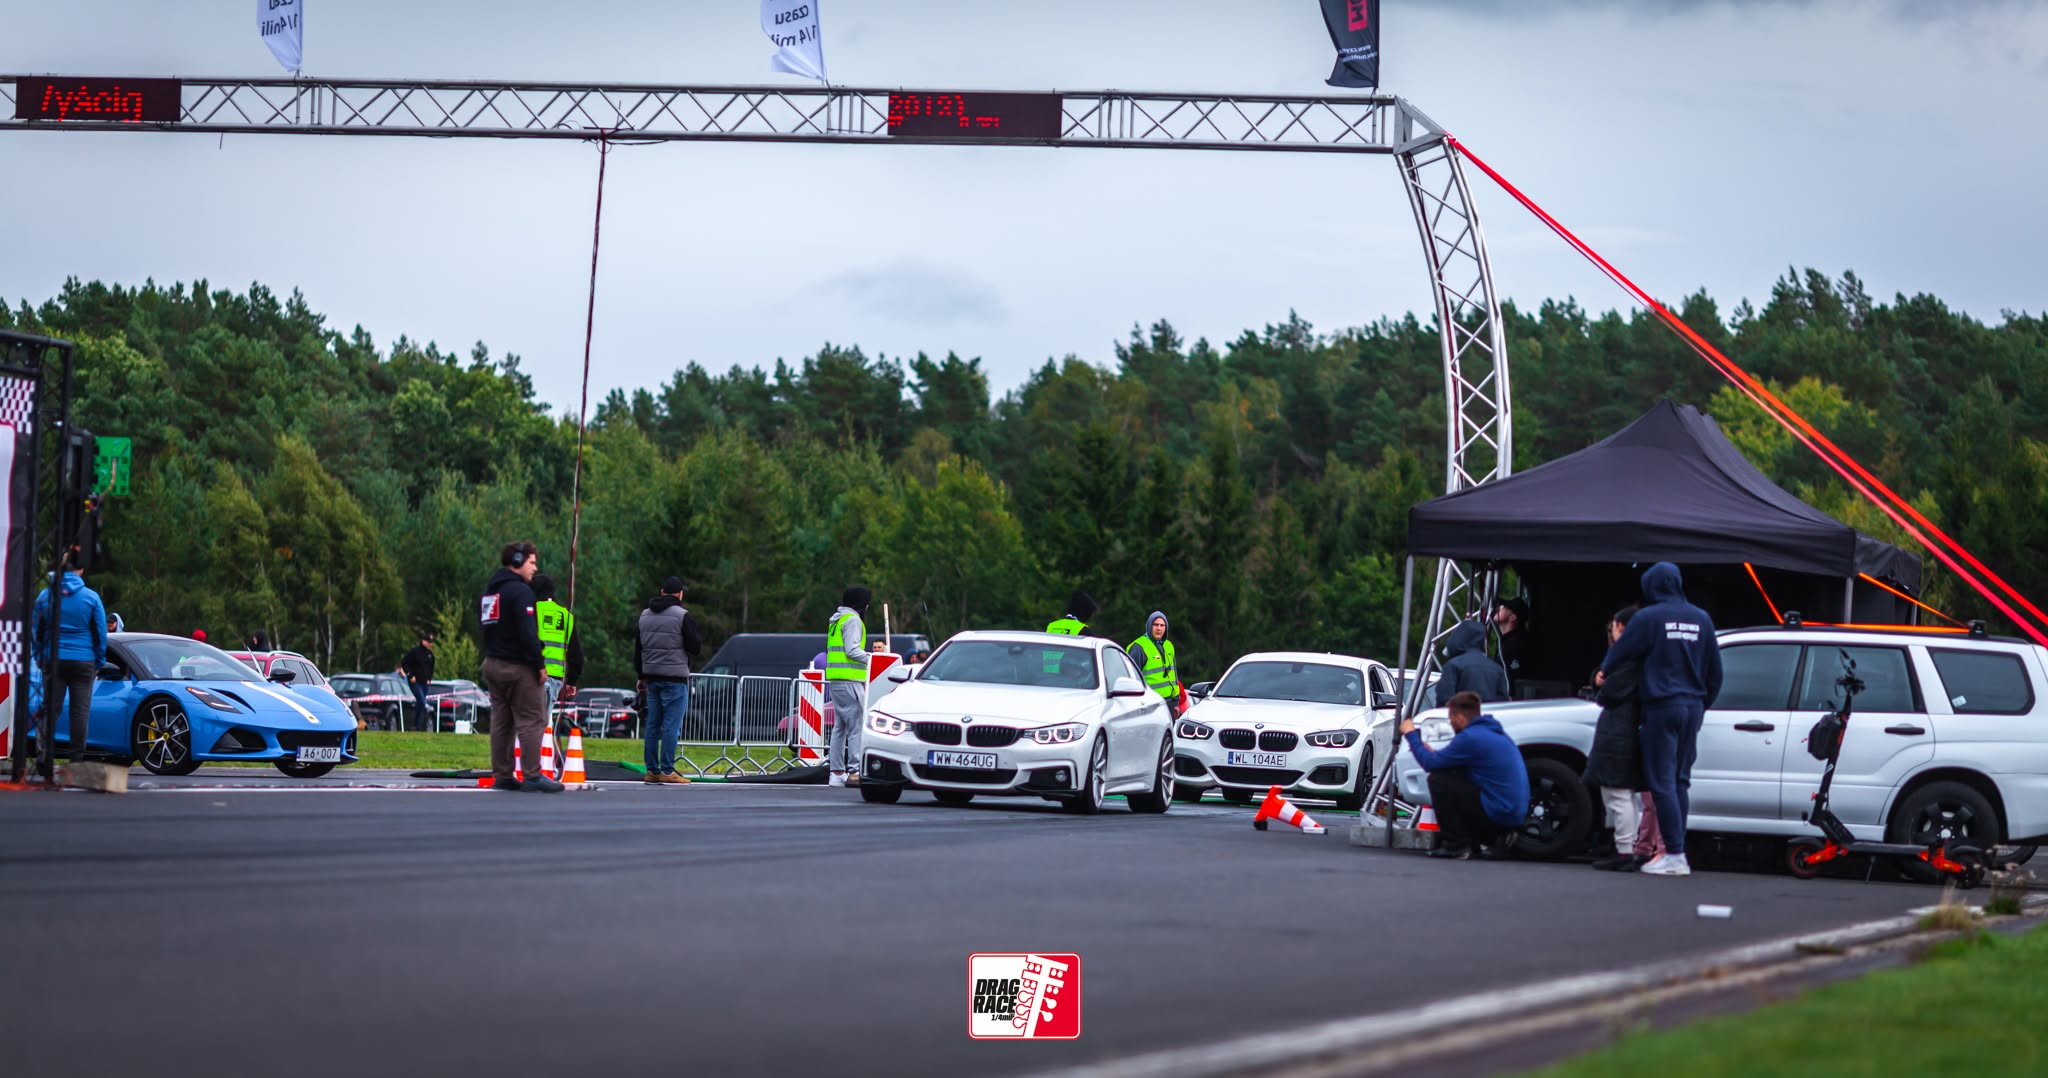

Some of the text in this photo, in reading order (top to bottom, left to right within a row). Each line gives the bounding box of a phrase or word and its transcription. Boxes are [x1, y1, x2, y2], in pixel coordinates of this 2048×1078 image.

[304, 748, 337, 759] A6 007
[936, 751, 993, 767] WW 464UG
[1235, 751, 1284, 766] WL 104AE
